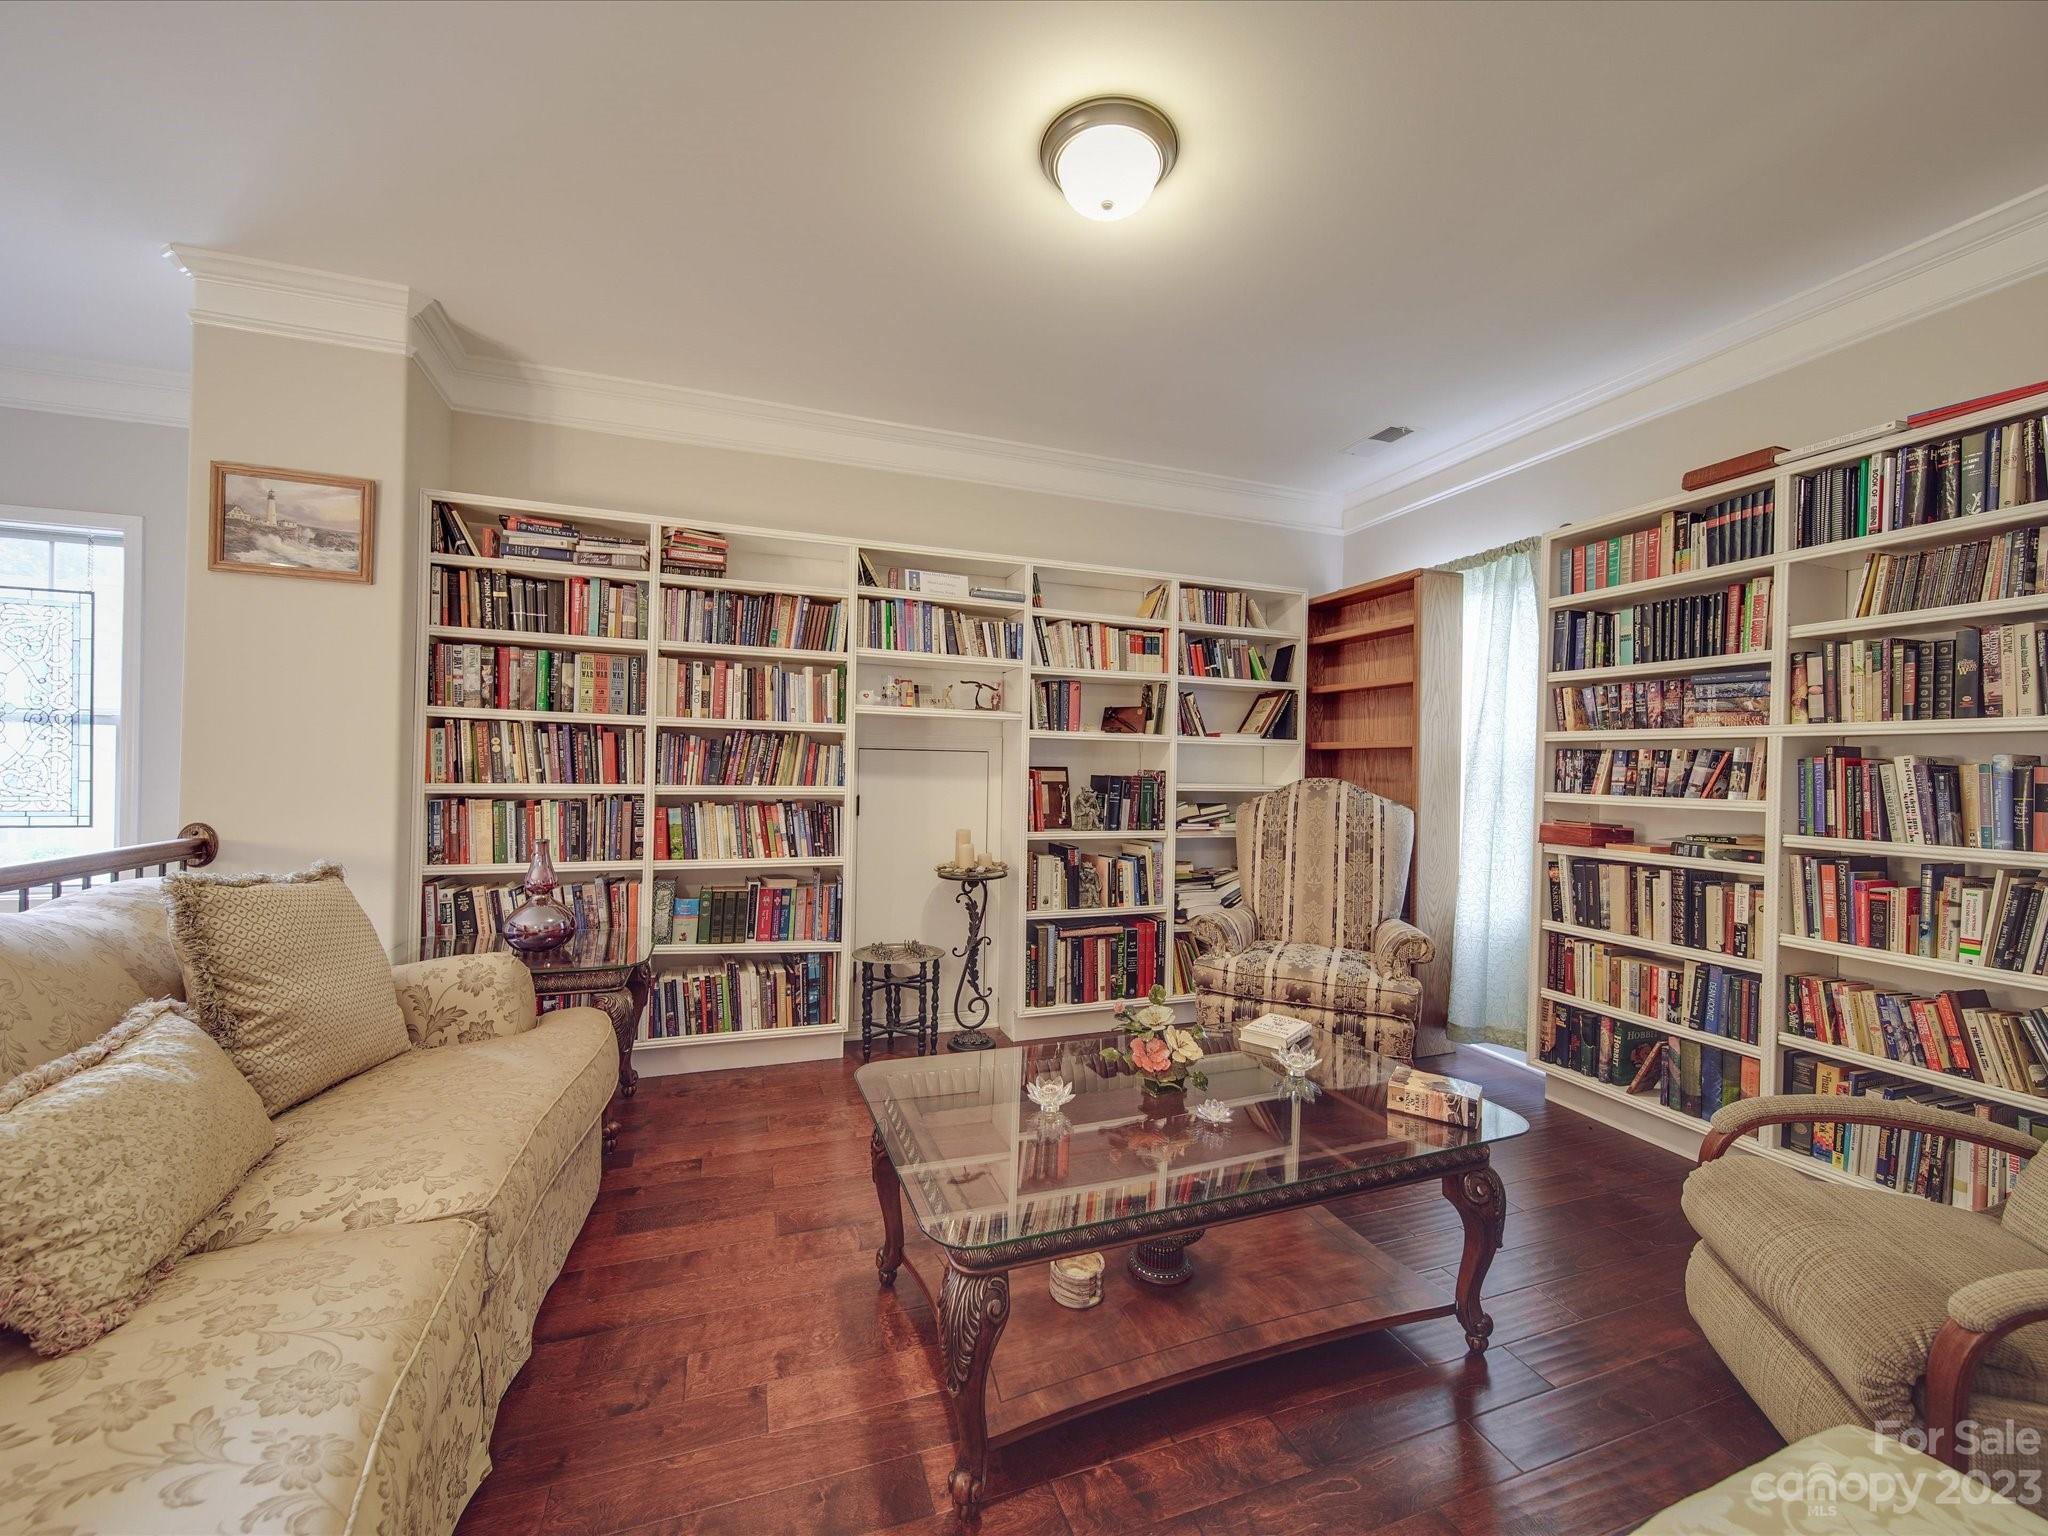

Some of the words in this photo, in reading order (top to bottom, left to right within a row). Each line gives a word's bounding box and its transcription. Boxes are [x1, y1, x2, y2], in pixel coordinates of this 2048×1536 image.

[1871, 469, 1879, 488] BOOK
[1871, 489, 1878, 497] OF
[1981, 634, 1990, 664] KIPLING
[1989, 630, 2000, 666] RUDYARD
[2002, 627, 2013, 655] RAGTIME
[453, 650, 462, 670] D-DAY
[1937, 792, 1945, 821] COMPASS
[1838, 864, 1847, 901] COMPETITIVE
[1551, 885, 1559, 912] NARNIA
[1824, 900, 1834, 918] FINANCE
[1840, 902, 1848, 931] STRATEGY
[1709, 981, 1717, 998] DEAN
[1706, 998, 1715, 1022] KOONTZ
[1970, 1026, 1980, 1039] THE
[1974, 1039, 1986, 1058] WALL
[1990, 1165, 1998, 1188] Dummies
